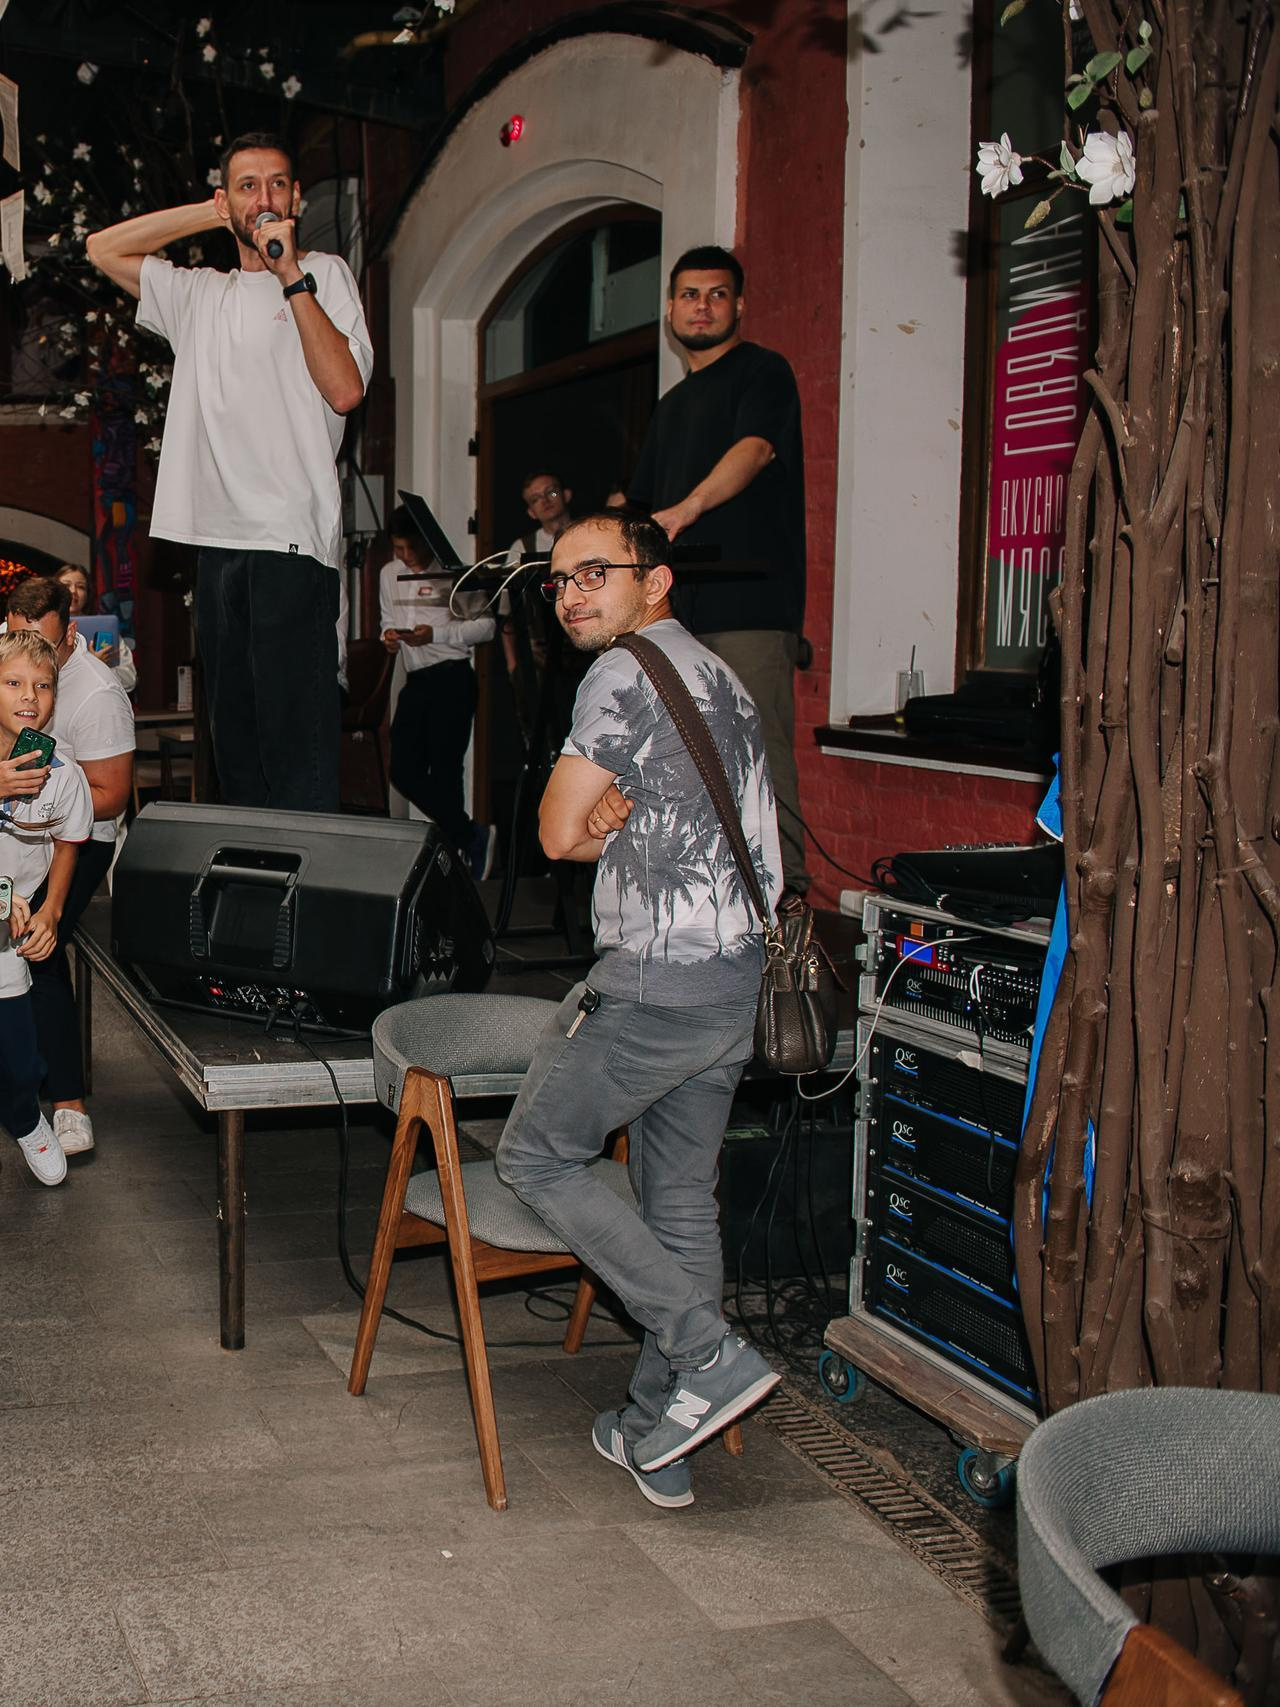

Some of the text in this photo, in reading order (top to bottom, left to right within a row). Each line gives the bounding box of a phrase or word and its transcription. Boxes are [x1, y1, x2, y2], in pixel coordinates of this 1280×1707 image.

[1003, 213, 1087, 457] ГОВЯДИНА
[1000, 474, 1071, 537] ВКУСНО
[906, 978, 923, 993] QSC
[895, 1047, 919, 1070] QSC
[892, 1120, 916, 1143] QSC
[889, 1192, 913, 1216] QSC
[886, 1263, 910, 1287] QSC
[666, 1388, 712, 1432] N
